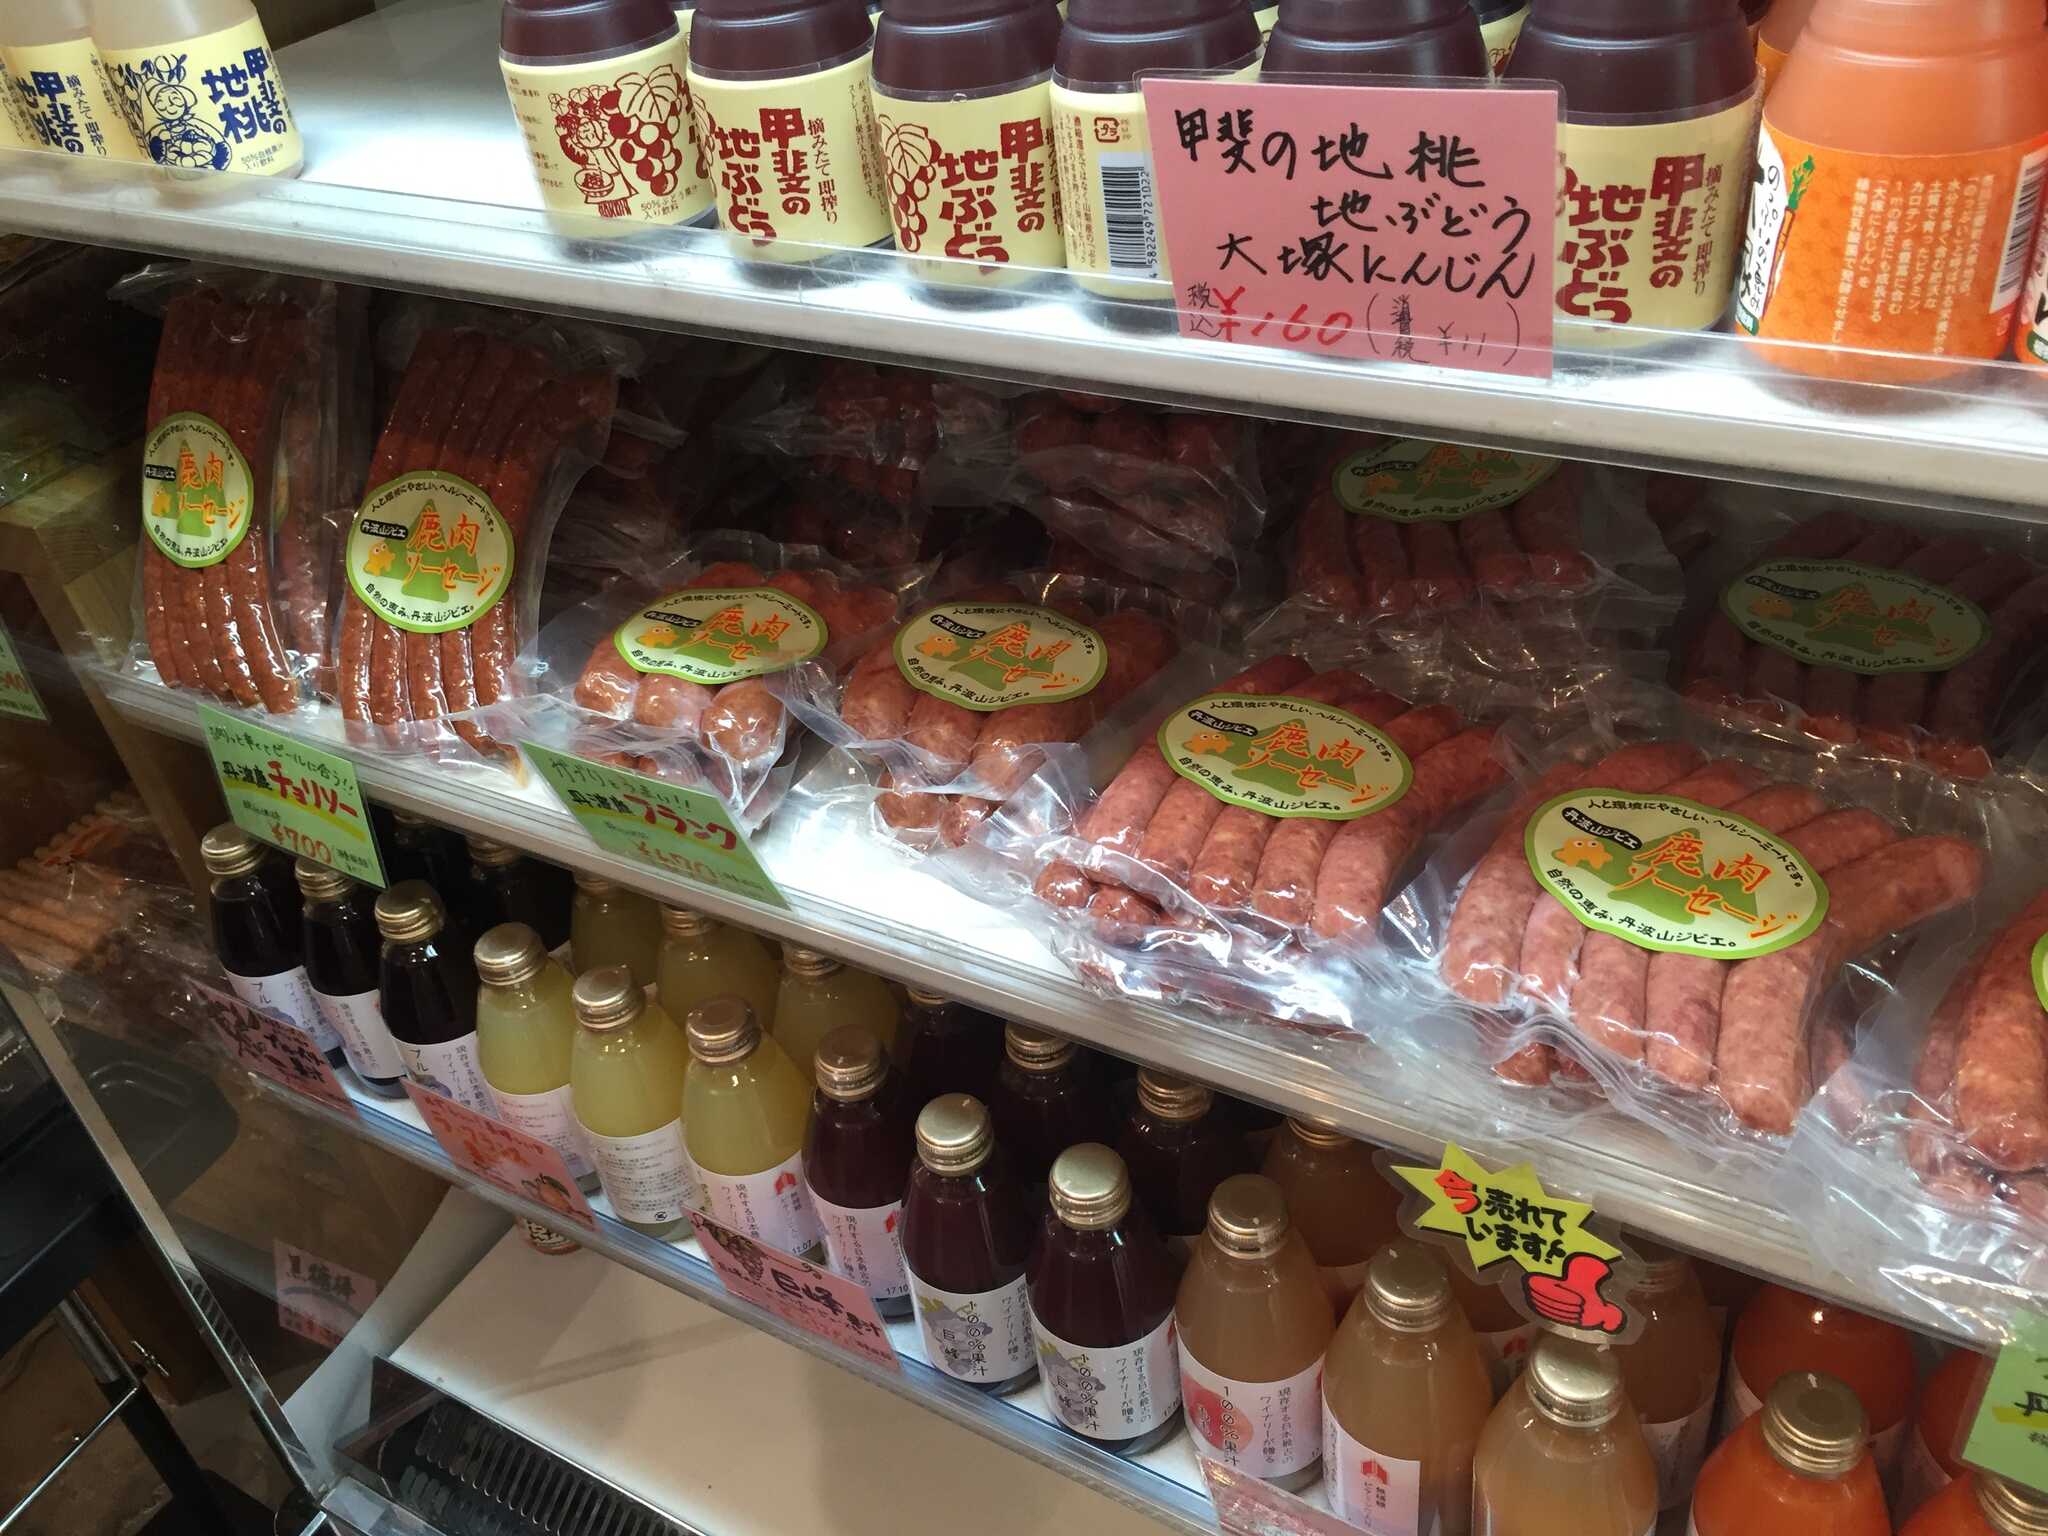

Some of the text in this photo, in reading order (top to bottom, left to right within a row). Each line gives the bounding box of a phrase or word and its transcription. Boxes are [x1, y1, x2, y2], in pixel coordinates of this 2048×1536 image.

[31, 71, 84, 153] 甲斐の
[201, 64, 271, 144] 地桃
[243, 47, 287, 134] 甲斐の
[759, 108, 811, 215] 甲斐の
[808, 117, 838, 224] 摘みたて 即搾り
[1000, 117, 1046, 233] 甲斐の
[1174, 108, 1486, 188] 甲斐の地桃
[714, 126, 777, 247] 地ぶどう
[935, 148, 1010, 276] 地ぶどう
[1649, 153, 1706, 288] 甲斐の
[1701, 164, 1723, 237] 摘みたて
[1311, 189, 1531, 255] 地ぶどう
[1555, 184, 1647, 324] 地ぶどう
[1216, 232, 1536, 300] 大塚にんじん
[406, 505, 480, 555] 鹿肉
[365, 583, 474, 623] 自然の恵み、丹波山ジビエ。
[402, 552, 500, 597] ソーセージ
[707, 606, 791, 641] 鹿肉
[968, 647, 1081, 689] ソーセージ
[1190, 712, 1257, 736] 丹波山ジビエ
[1210, 701, 1392, 763] 人と環境にやさしい、ヘルシーミートです。
[1251, 723, 1367, 768] 鹿肉
[267, 760, 358, 817] チョリソー
[1178, 757, 1341, 810] 自然の恵み、丹波山ジビエ。
[1238, 749, 1390, 804] ソーセージ
[623, 793, 737, 850] フランク
[1564, 808, 1641, 849] 丹波山ジビエ
[1588, 799, 1804, 888] 人と環境にやさしい、ヘルシーミートです。
[1633, 832, 1772, 893] 鹿肉
[1546, 868, 1736, 948] 自然の恵み、丹波山ジビエ。
[1615, 864, 1798, 939] ソーセージ
